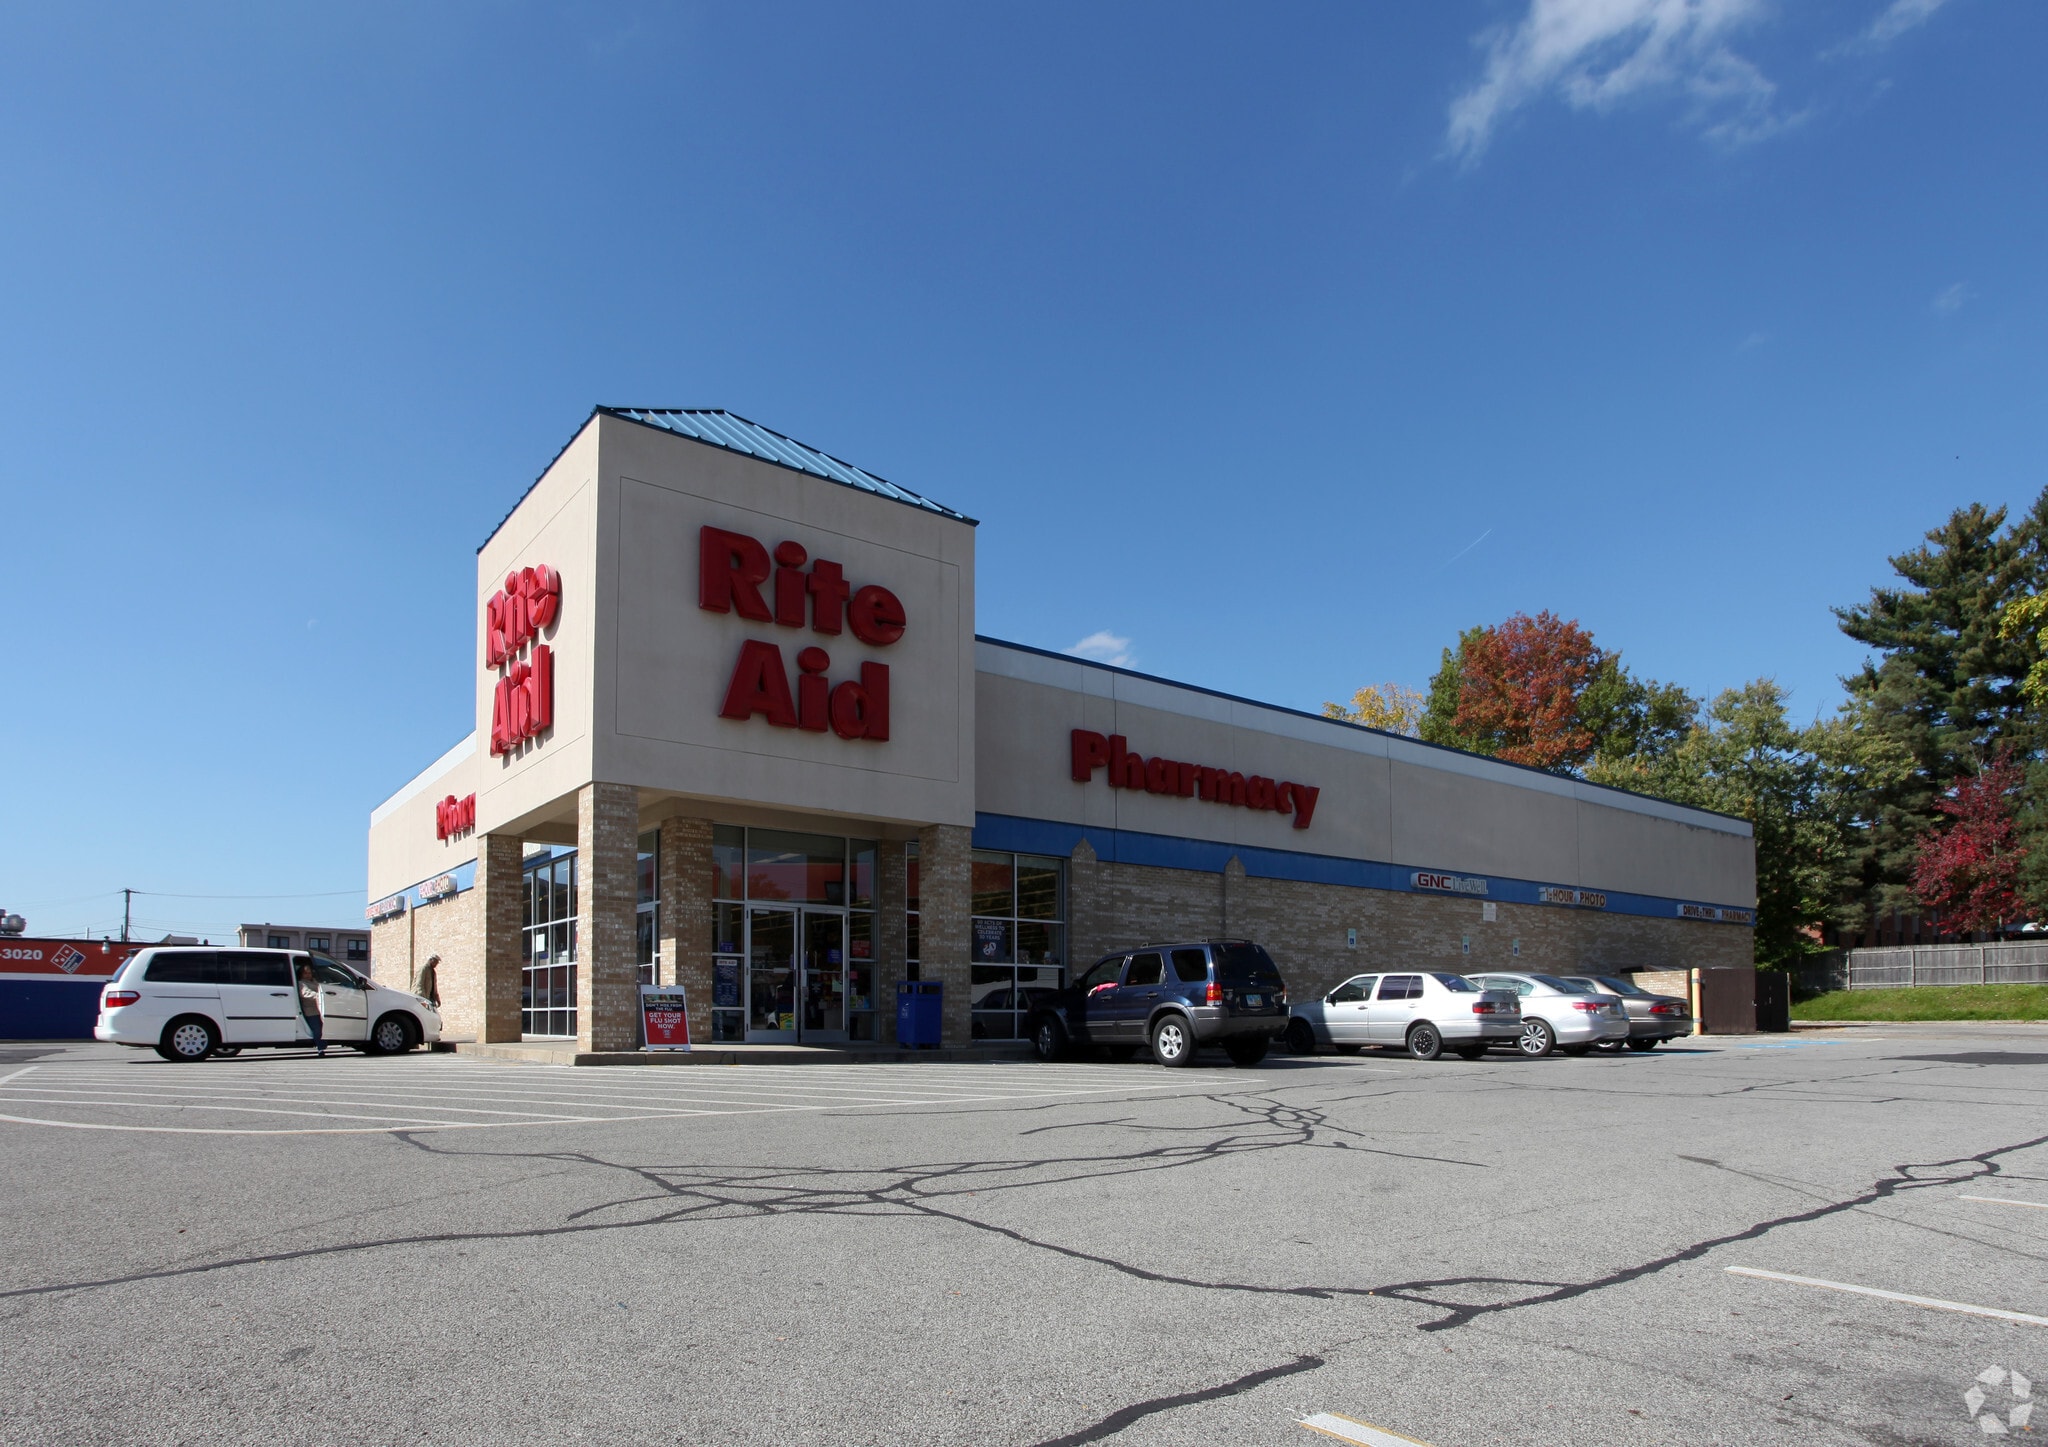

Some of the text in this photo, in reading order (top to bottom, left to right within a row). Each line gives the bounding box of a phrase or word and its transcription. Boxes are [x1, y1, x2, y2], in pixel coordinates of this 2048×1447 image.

[486, 564, 558, 671] Rite
[699, 525, 906, 646] Rite
[490, 644, 550, 758] Aid
[718, 639, 889, 742] Aid
[1071, 729, 1320, 829] Pharmacy
[1417, 873, 1451, 890] GNC
[1579, 891, 1606, 907] PHOTO
[1721, 908, 1751, 922] PHARMACY
